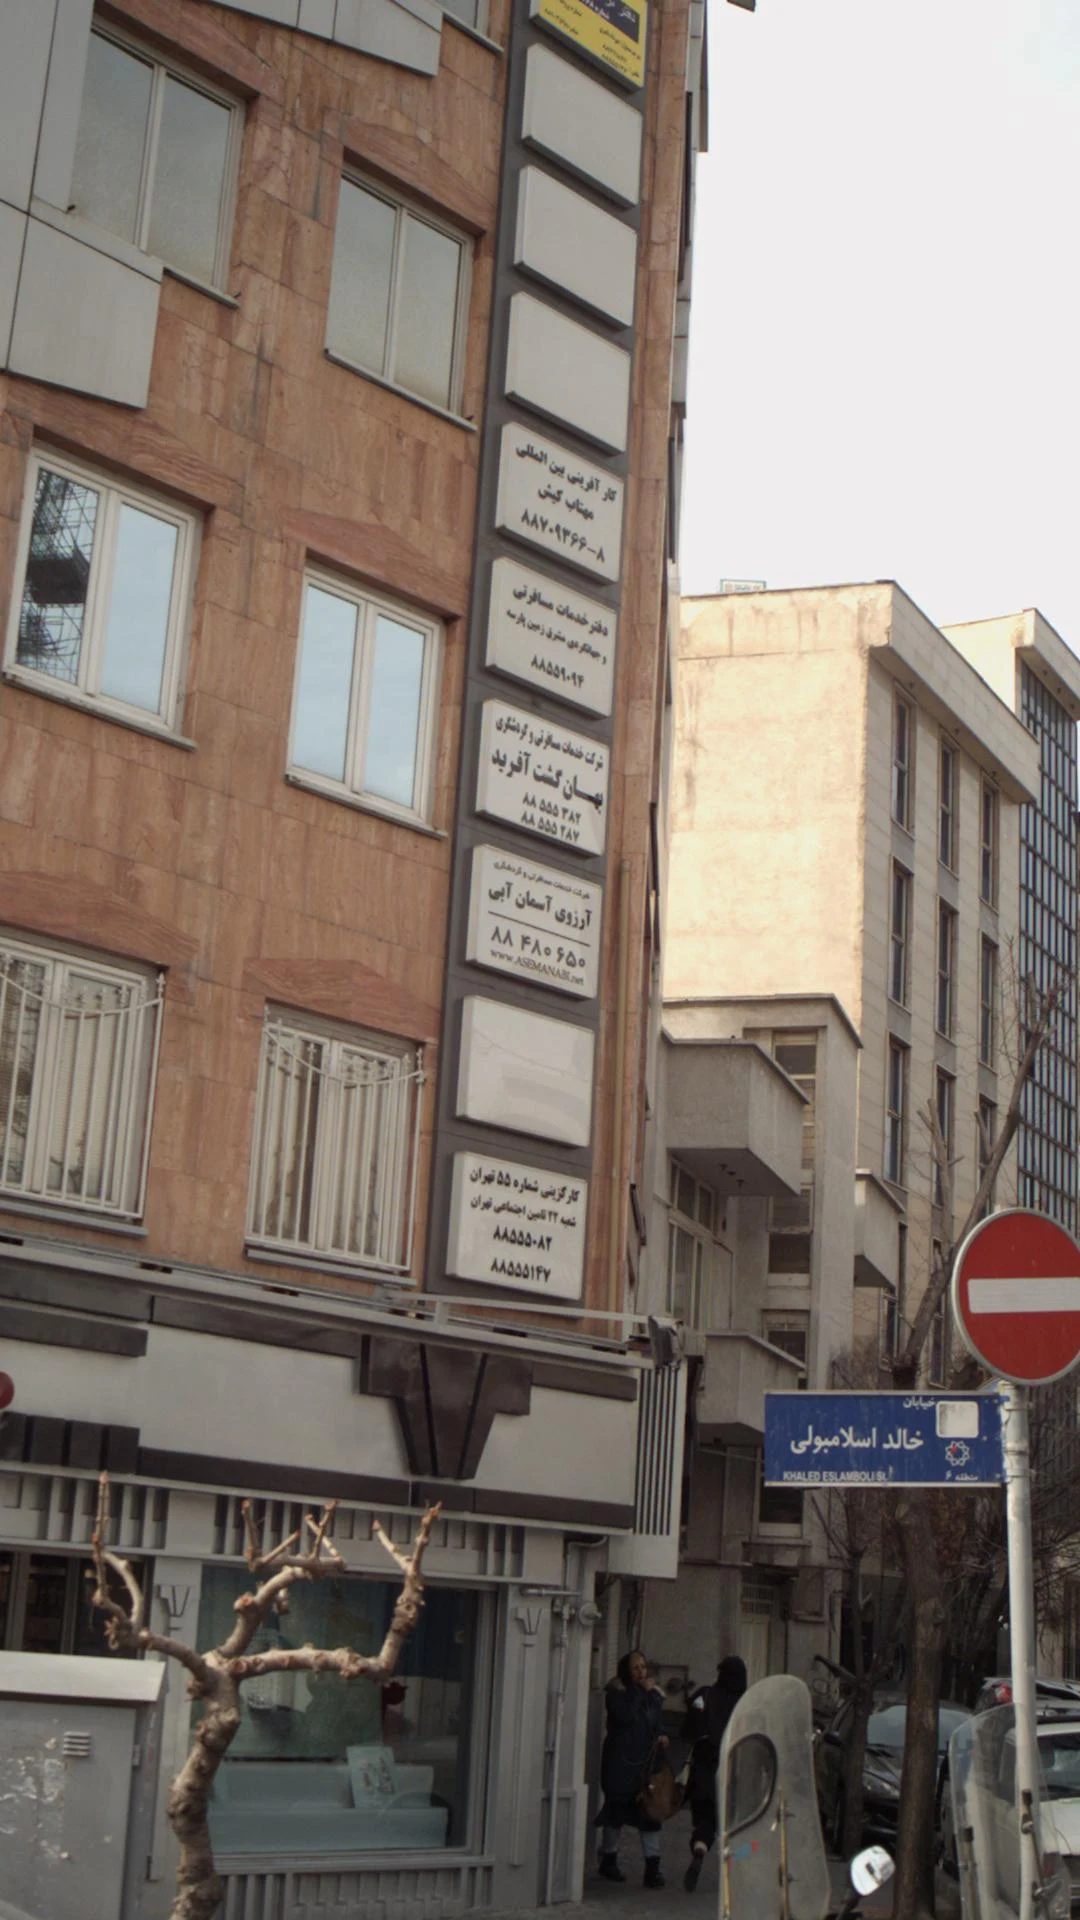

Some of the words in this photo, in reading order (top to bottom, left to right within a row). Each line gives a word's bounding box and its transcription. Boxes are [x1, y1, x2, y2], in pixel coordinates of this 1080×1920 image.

[515, 443, 548, 465] المللی
[549, 461, 565, 478] بین
[565, 498, 594, 520] مهتاب
[512, 585, 554, 610] مسافرتی
[555, 605, 589, 626] خدمات
[588, 619, 608, 636] دفتر
[562, 741, 584, 760] خدمات
[533, 764, 562, 789] گشت
[488, 881, 514, 903] آبی
[515, 889, 553, 913] آسمان
[555, 908, 593, 931] آرزوی
[469, 1167, 496, 1185] تهران
[496, 1170, 511, 1187] ۵۵
[513, 1176, 539, 1194] شماره
[470, 1194, 493, 1211] تهران
[493, 1201, 527, 1217] اجتماعی
[902, 1396, 936, 1410] خیابان
[790, 1424, 877, 1454] اسلامبولی
[882, 1427, 924, 1450] خالد
[782, 1470, 821, 1481] KHALED
[822, 1470, 874, 1481] ESLAMBOLI
[955, 1472, 979, 1481] منطقه
